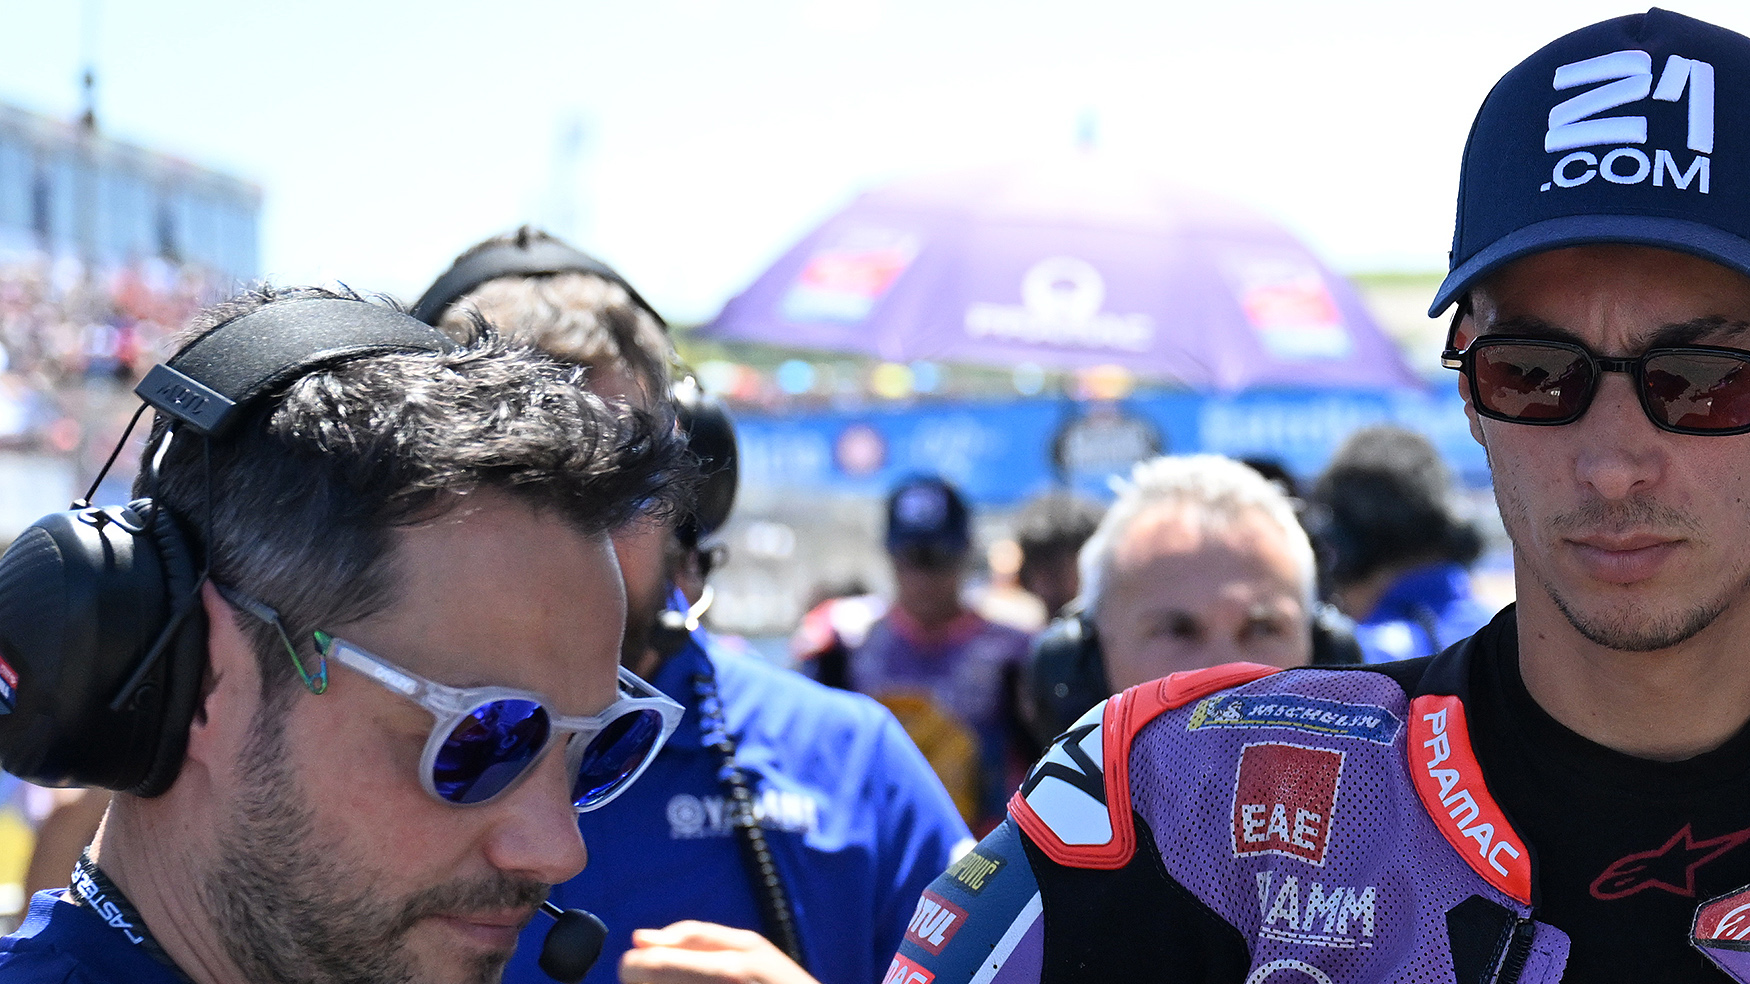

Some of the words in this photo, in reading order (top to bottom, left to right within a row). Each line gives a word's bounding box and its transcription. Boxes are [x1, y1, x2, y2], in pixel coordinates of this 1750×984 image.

[1544, 49, 1715, 154] 21
[1540, 148, 1711, 194] .COM
[1248, 703, 1382, 729] MICHELIN
[1423, 707, 1520, 877] PRAMAC
[1241, 803, 1322, 851] EAE
